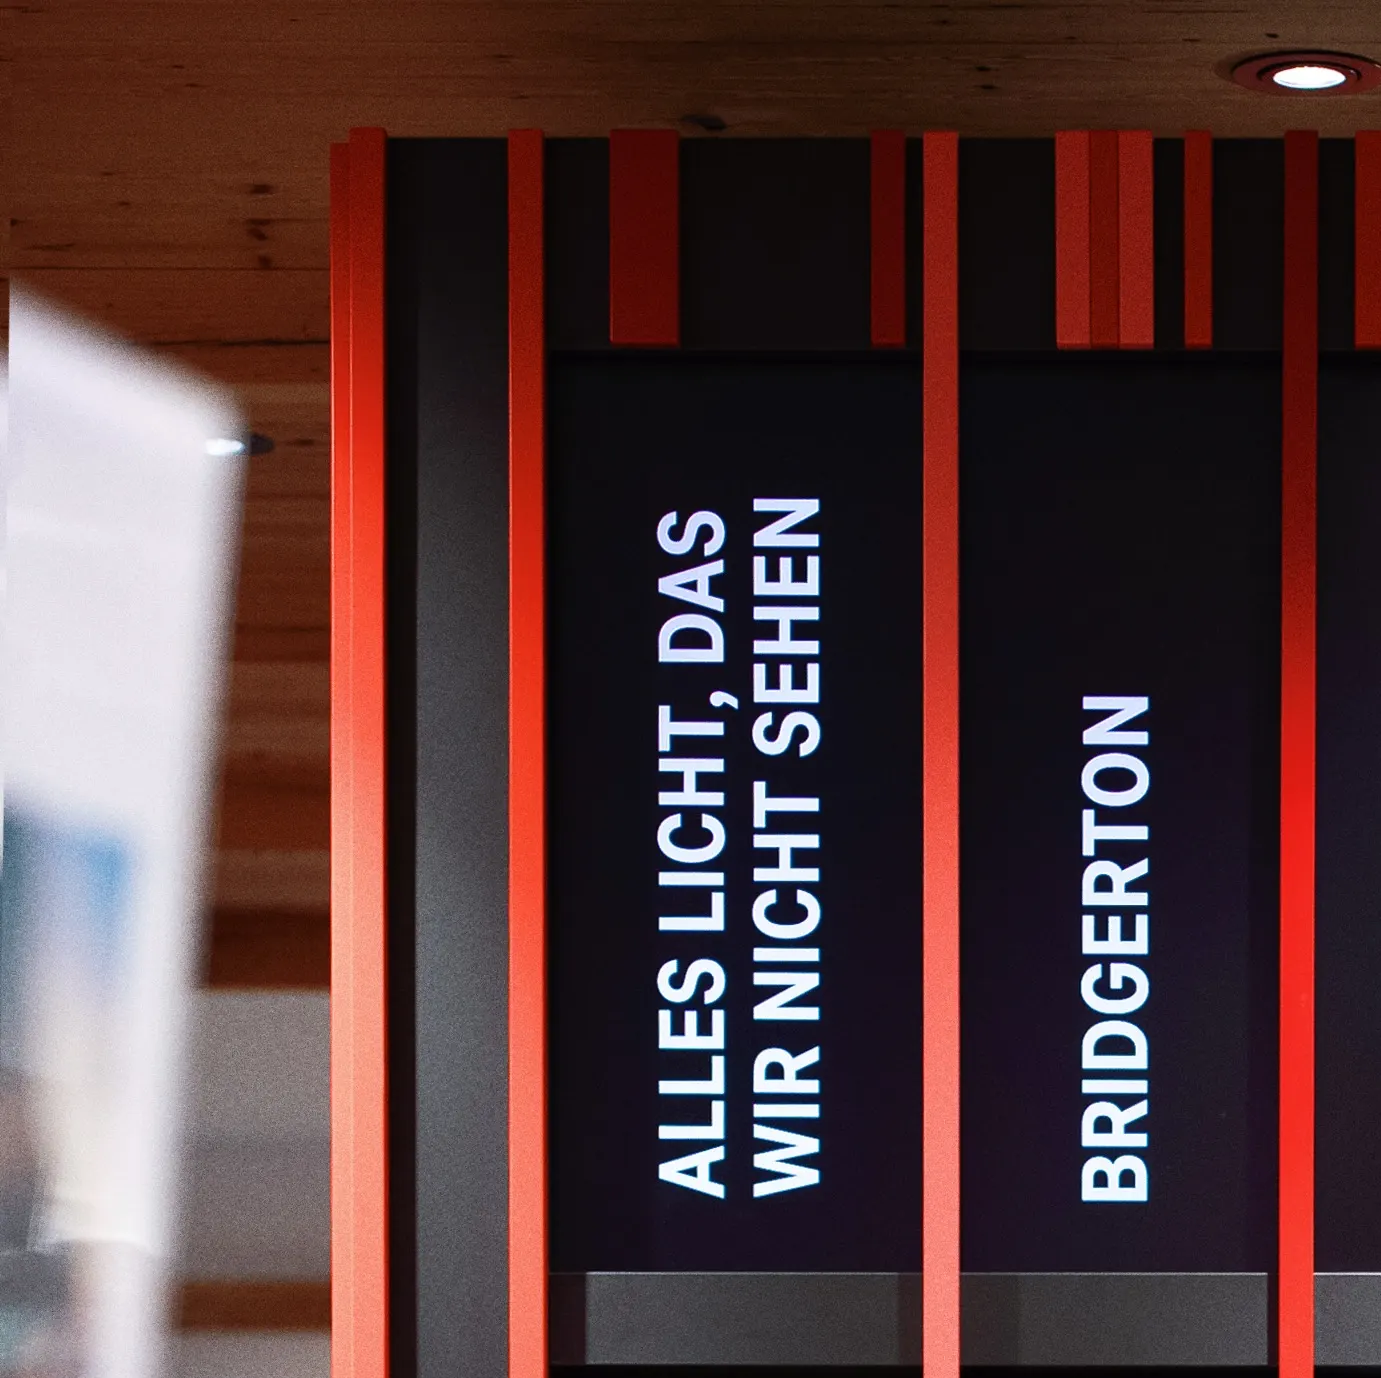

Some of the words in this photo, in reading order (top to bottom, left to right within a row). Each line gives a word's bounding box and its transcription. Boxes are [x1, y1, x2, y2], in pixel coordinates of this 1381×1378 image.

[657, 510, 726, 663] DAS
[752, 498, 821, 756] SEHEN
[657, 690, 739, 932] LICHT,
[752, 780, 821, 1021] NICHT
[1081, 695, 1150, 1202] BRIDGERTON
[657, 959, 726, 1199] ALLES
[752, 1045, 820, 1197] WIR
